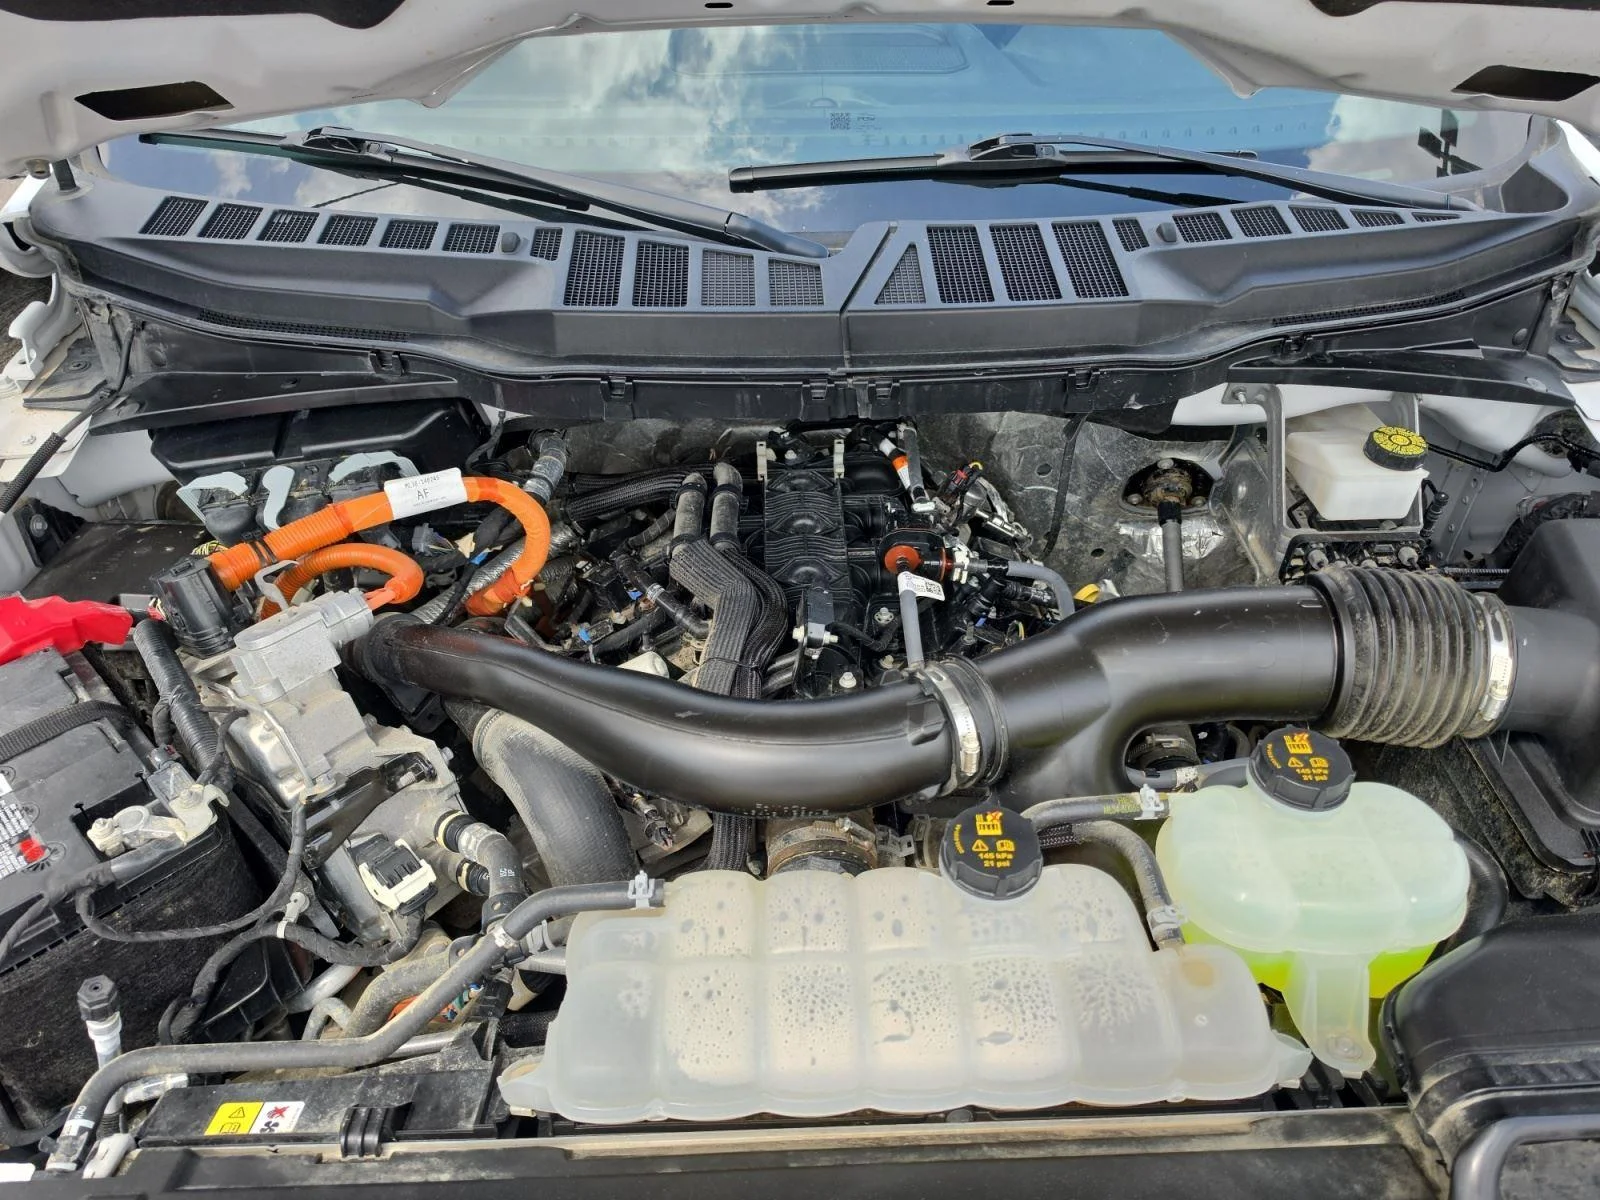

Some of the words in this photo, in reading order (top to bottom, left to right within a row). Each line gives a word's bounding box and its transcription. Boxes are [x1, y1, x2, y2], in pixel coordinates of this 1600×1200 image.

[417, 488, 430, 501] AF
[983, 860, 995, 868] 21
[996, 860, 1011, 868] psi
